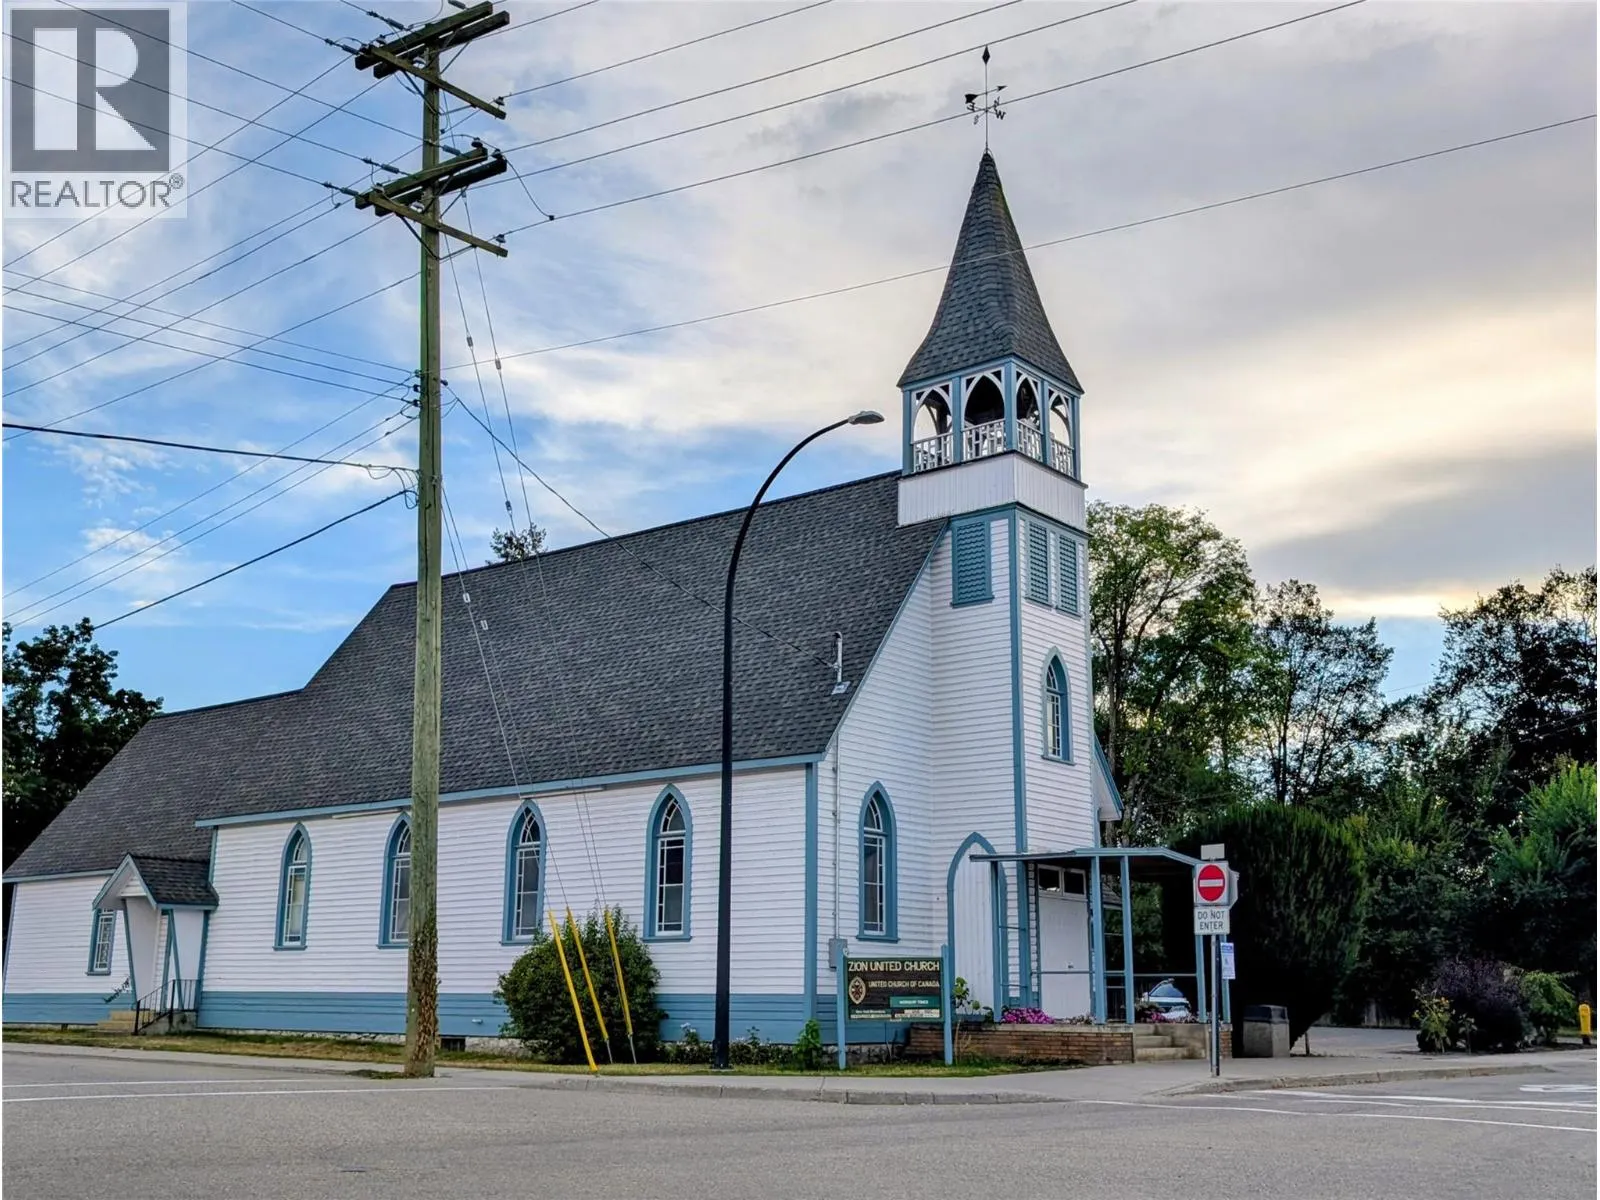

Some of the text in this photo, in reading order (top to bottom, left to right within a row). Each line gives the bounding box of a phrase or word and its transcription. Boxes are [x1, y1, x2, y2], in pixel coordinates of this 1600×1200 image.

[1197, 910, 1225, 920] DO NOT
[1200, 921, 1224, 930] ENTER
[848, 961, 940, 971] ZION UNITED CHURCH
[868, 980, 940, 988] UNITED CHURCH OF CANADA
